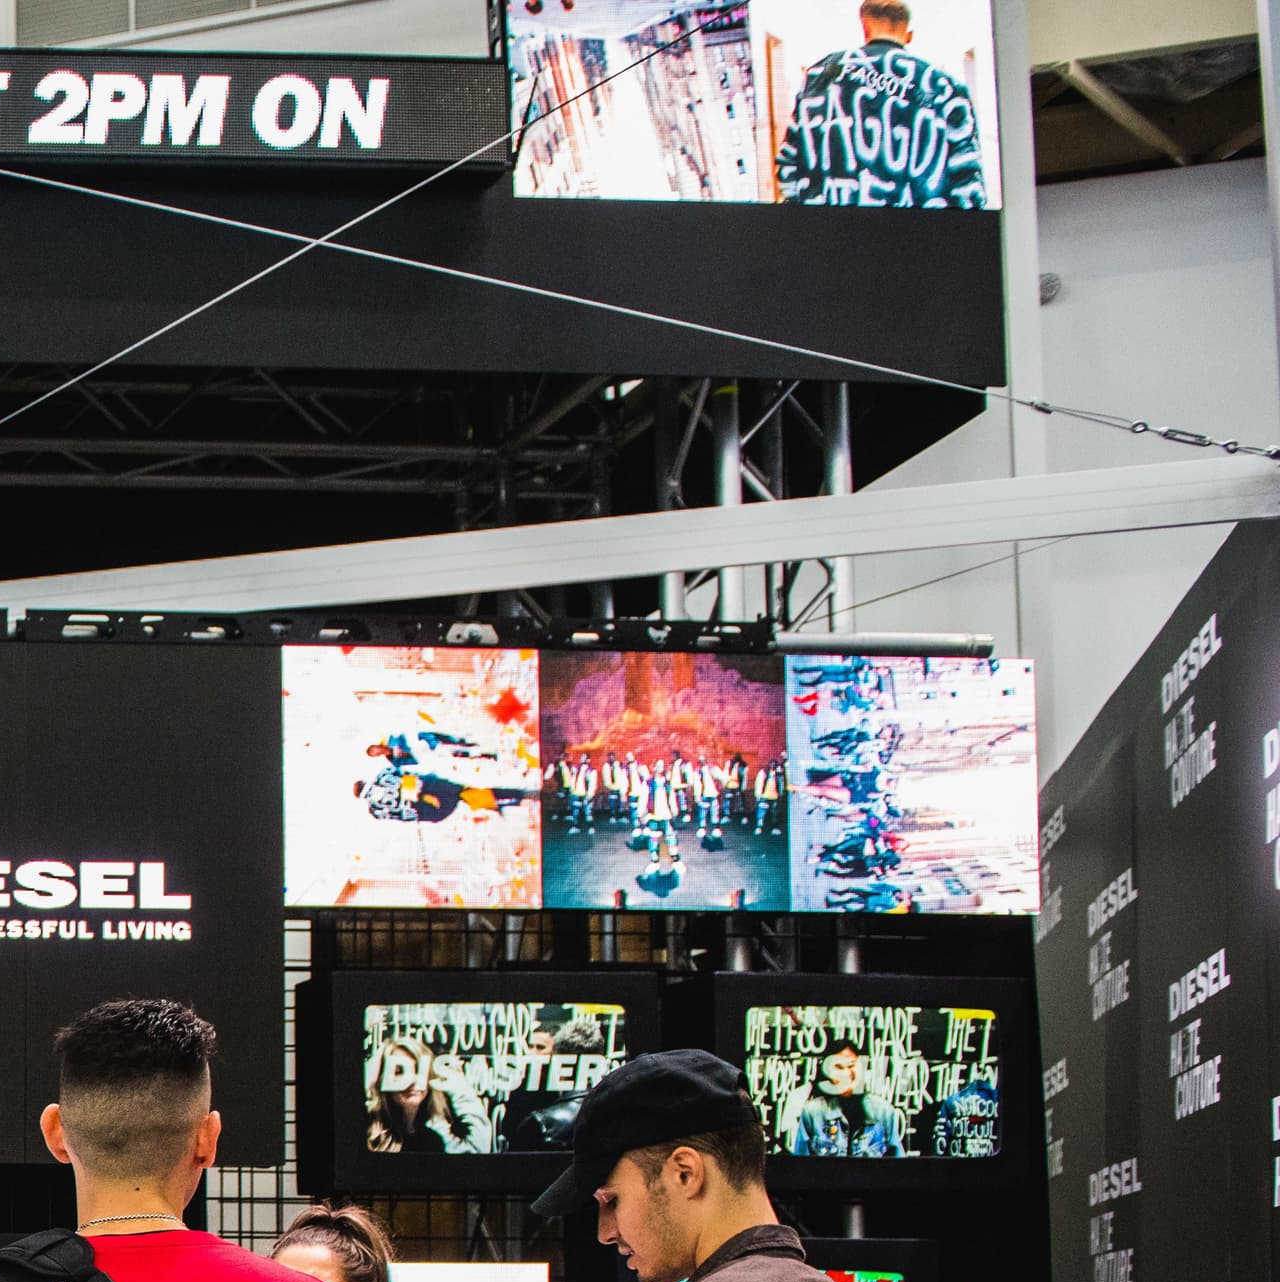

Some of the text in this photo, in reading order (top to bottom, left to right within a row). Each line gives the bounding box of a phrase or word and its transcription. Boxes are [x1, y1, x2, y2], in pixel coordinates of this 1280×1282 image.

[27, 70, 231, 146] 2PM
[251, 74, 390, 148] ON
[1161, 613, 1222, 714] DIESEL
[102, 921, 192, 941] LIVING
[1088, 867, 1138, 937] DIESEL
[1169, 948, 1231, 1022] DIESEL
[1090, 1157, 1142, 1207] DIESEL
